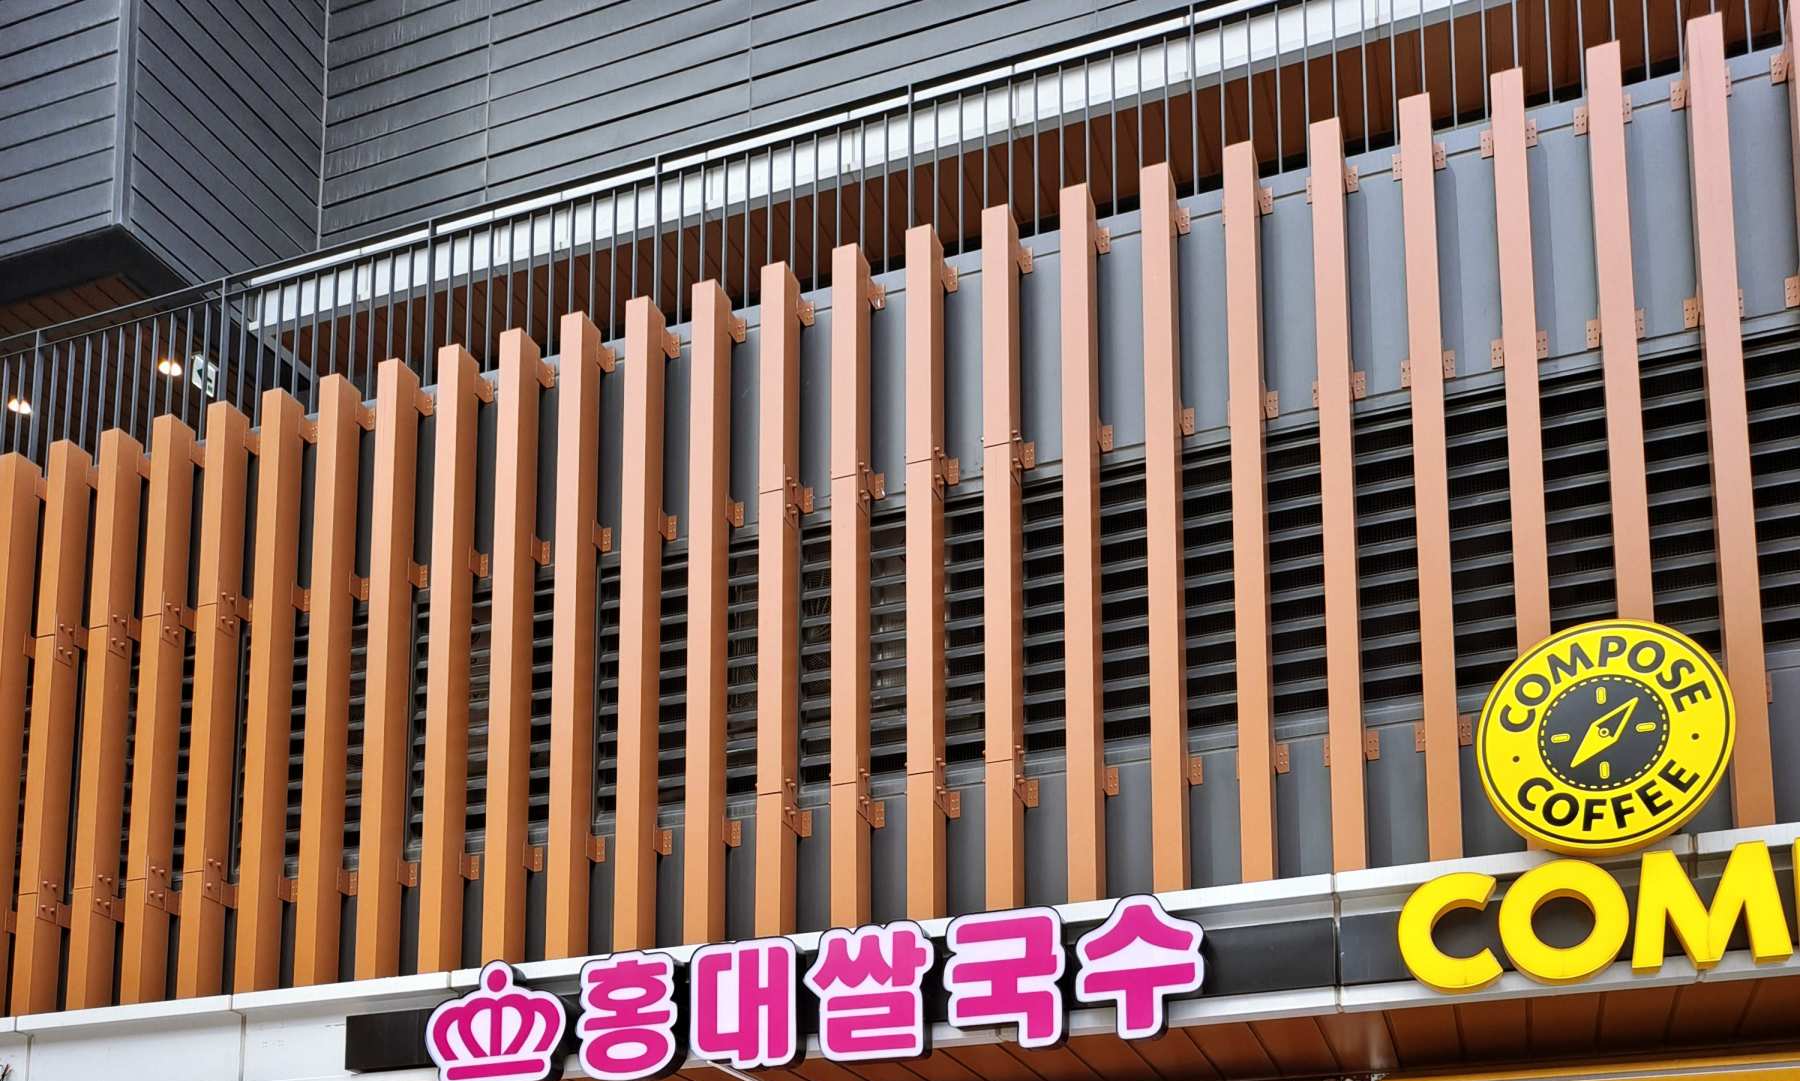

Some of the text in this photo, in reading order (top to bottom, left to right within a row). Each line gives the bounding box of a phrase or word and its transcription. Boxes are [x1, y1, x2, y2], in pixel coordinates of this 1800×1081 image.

[1499, 635, 1713, 734] COMPOSE
[1516, 759, 1700, 832] COFFEE
[580, 900, 1200, 1078] 홍대쌀국수
